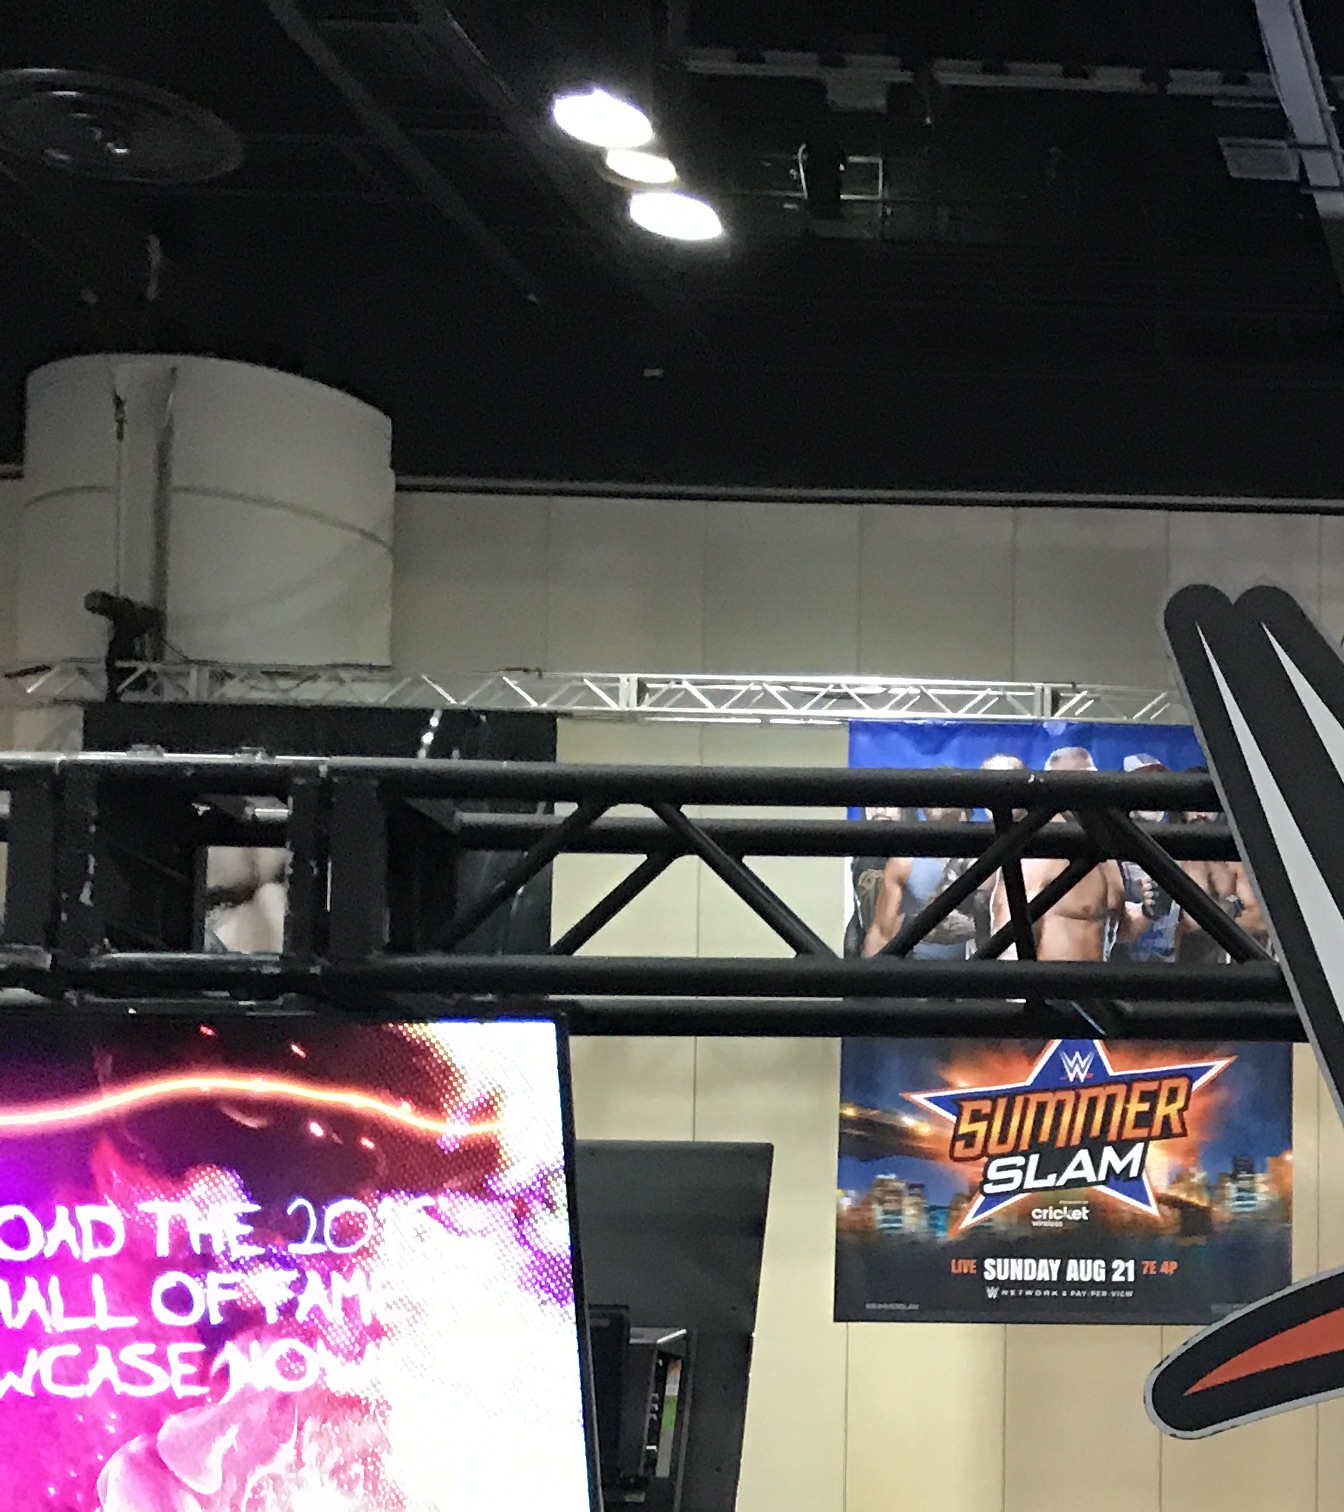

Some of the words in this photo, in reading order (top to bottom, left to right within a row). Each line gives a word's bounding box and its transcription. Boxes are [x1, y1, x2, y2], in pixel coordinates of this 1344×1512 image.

[954, 1077, 1190, 1160] SUMMER
[983, 1142, 1145, 1194] SLAM
[138, 1199, 263, 1260] THE
[1031, 1205, 1090, 1220] cricket
[950, 1258, 977, 1276] LIVE
[983, 1257, 1062, 1282] SUNDAY
[1066, 1258, 1107, 1282] AUG
[1111, 1259, 1135, 1282] 21
[1001, 1289, 1059, 1298] NETWORK
[150, 1271, 241, 1326] OF
